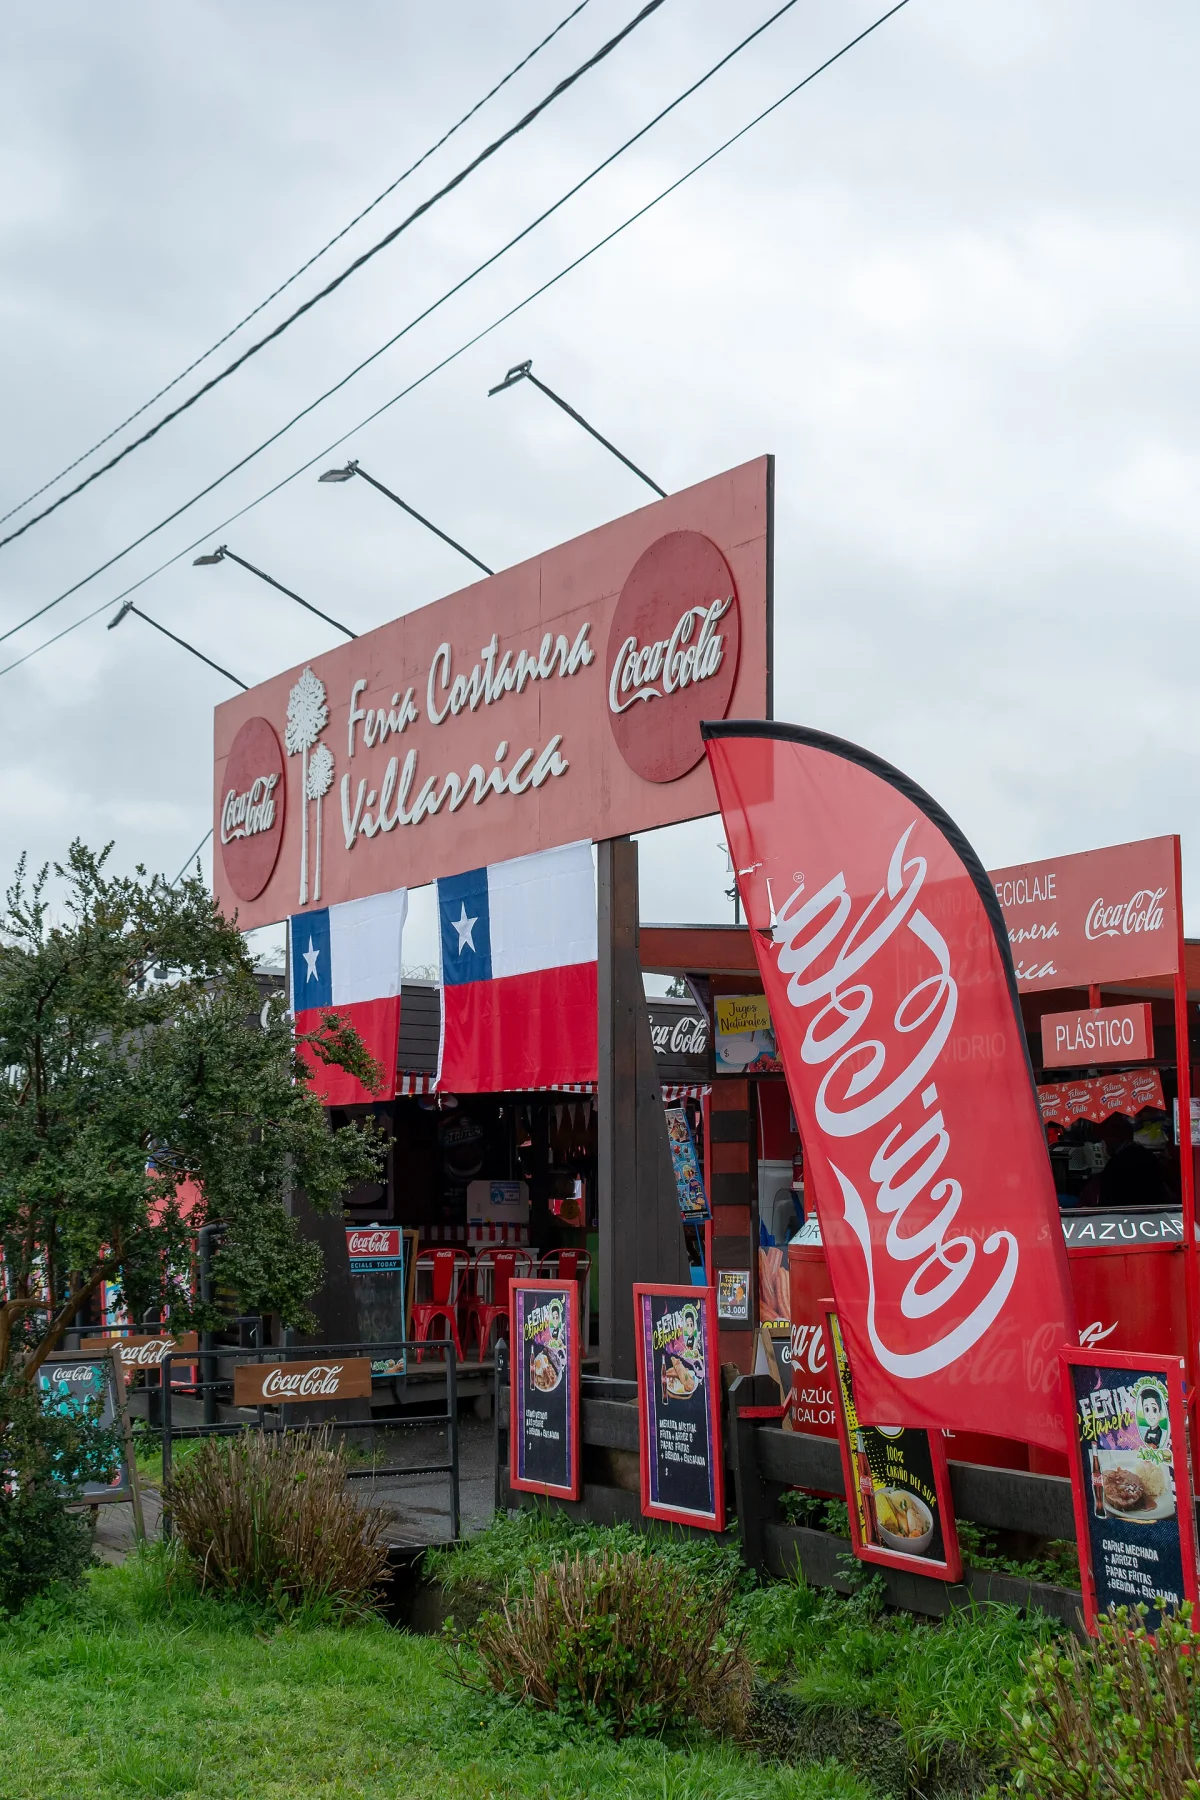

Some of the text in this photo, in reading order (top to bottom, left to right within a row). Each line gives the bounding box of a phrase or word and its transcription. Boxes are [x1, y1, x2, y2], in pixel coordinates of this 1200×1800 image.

[609, 595, 734, 714] Coca-Cola
[348, 622, 595, 757] Feria Costanera
[340, 735, 569, 849] Villarrica
[220, 772, 282, 847] Coca-Cola
[995, 873, 1057, 907] ECICLAJE
[1084, 887, 1168, 941] Coca-Cola
[720, 1013, 767, 1032] Naturales
[729, 1002, 758, 1019] Jugos
[1055, 1017, 1134, 1051] PLÁSTICO
[349, 1232, 391, 1253] Coca-Cola
[52, 1366, 93, 1382] Coca-Cola
[262, 1364, 344, 1398] Coca-Cola
[800, 1387, 834, 1404] AZÚC
[886, 1445, 904, 1463] 100%
[910, 1474, 920, 1492] DEL
[922, 1485, 937, 1507] SUR
[1102, 1539, 1159, 1562] CARNE MECHADA
[1111, 1553, 1133, 1566] ARROZ
[1105, 1565, 1153, 1586] PAPAS FRITAS
